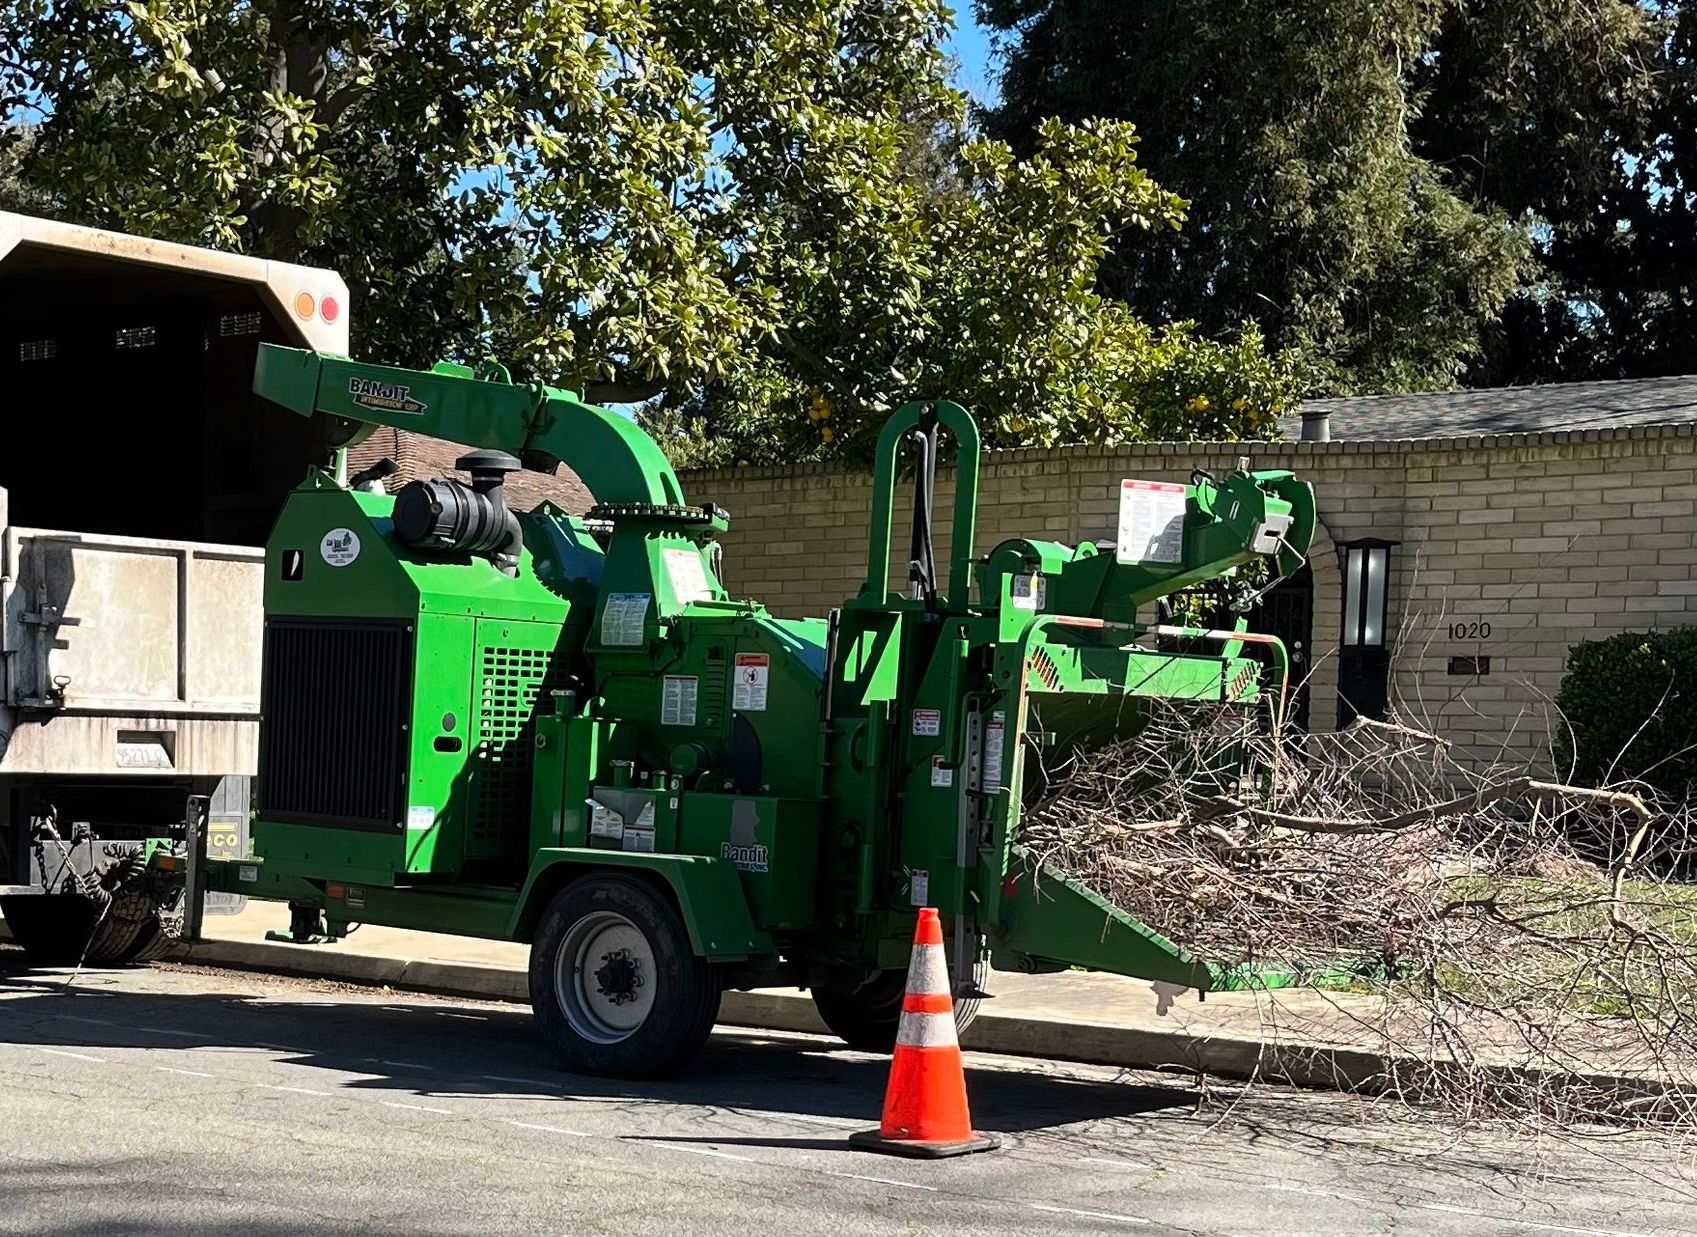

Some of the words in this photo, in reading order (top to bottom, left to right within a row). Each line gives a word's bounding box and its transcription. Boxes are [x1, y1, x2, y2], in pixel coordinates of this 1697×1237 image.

[350, 378, 410, 402] BANDIT
[1449, 622, 1491, 640] 1020
[721, 842, 768, 864] Bandit
